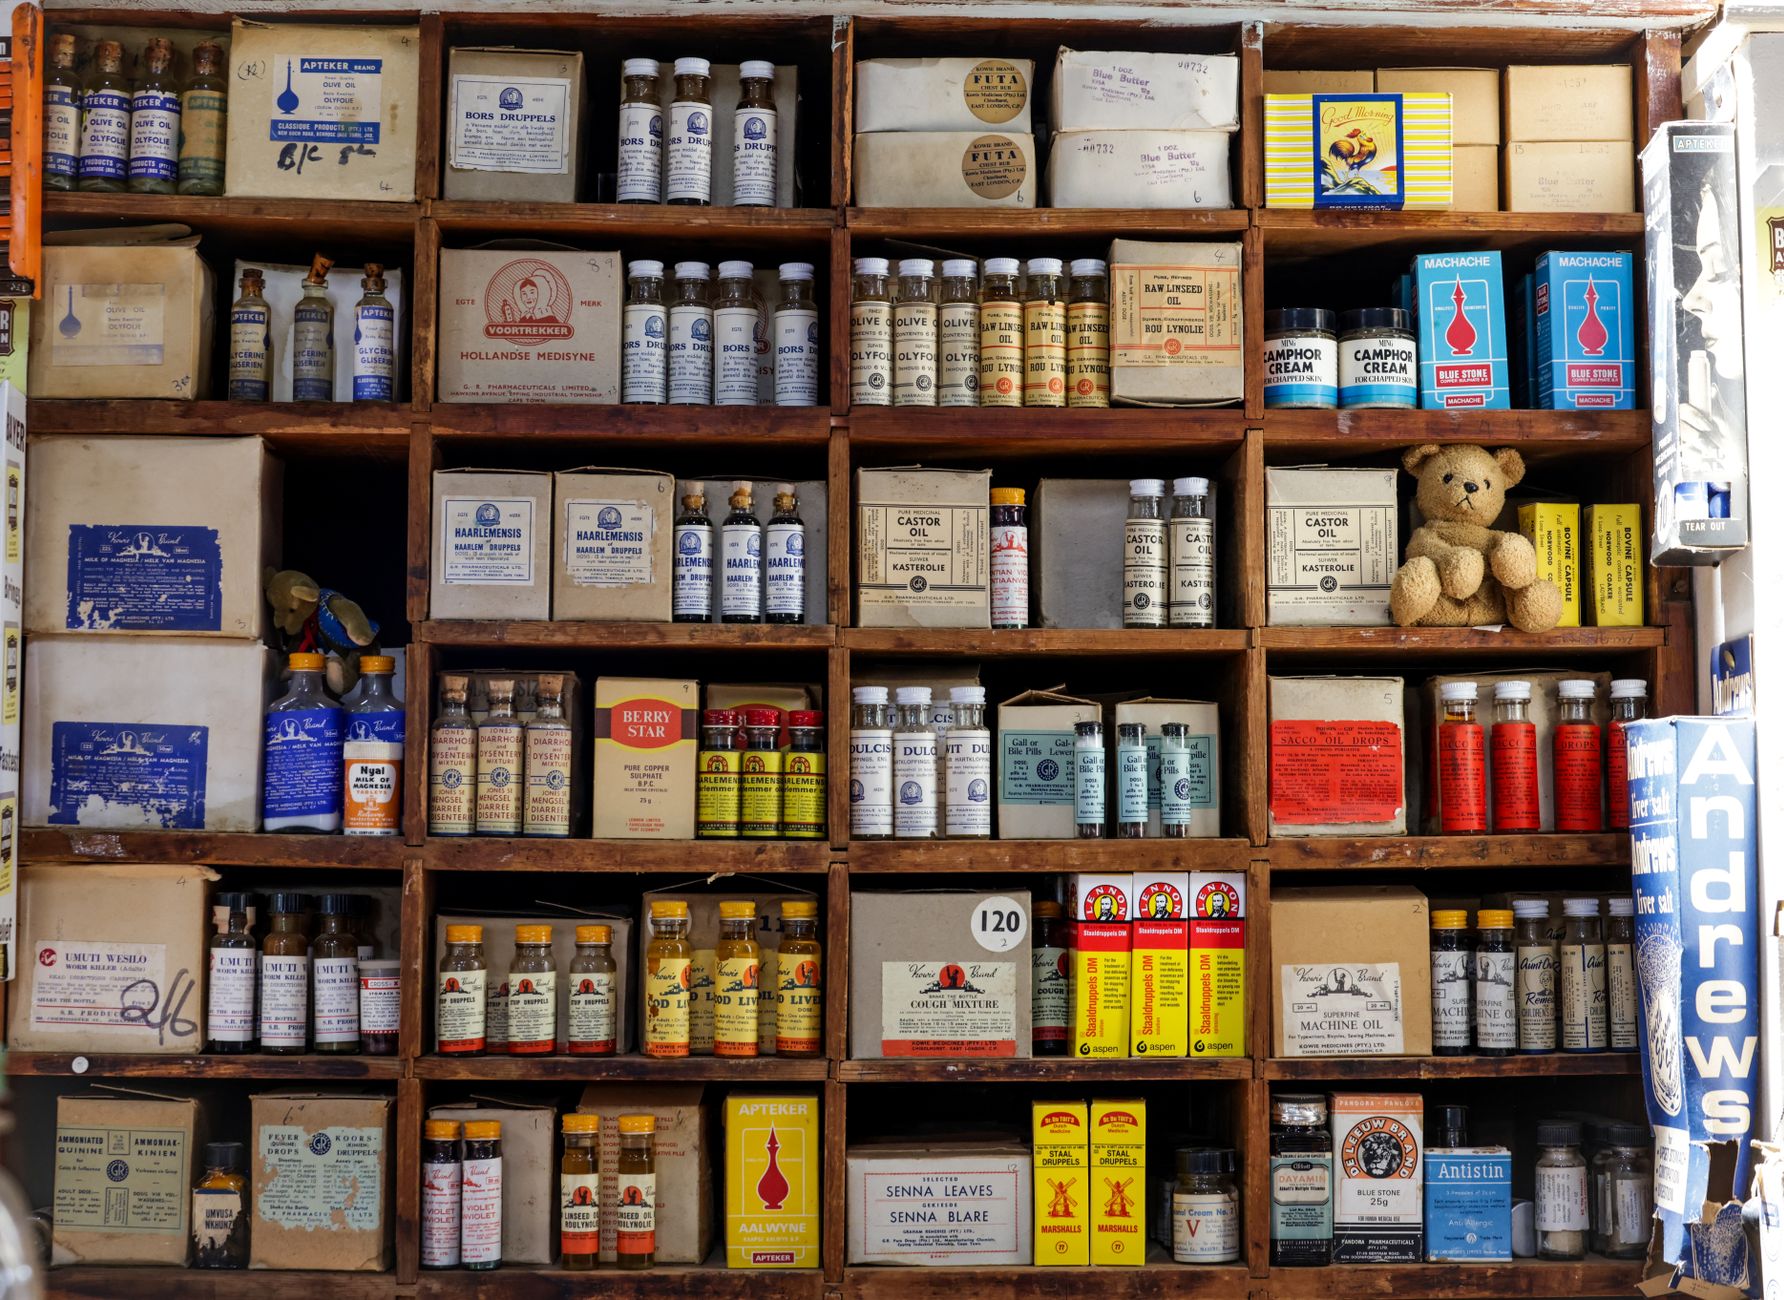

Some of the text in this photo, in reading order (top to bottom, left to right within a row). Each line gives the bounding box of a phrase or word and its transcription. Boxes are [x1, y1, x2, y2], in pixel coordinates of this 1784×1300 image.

[303, 61, 349, 71] APTEKER
[974, 74, 1018, 84] FUTA
[1093, 68, 1150, 86] Blue Butter
[466, 111, 555, 122] BORS DRUPPELS
[1321, 106, 1395, 127] Good Morning
[315, 123, 345, 131] PRODUCTS
[1424, 256, 1490, 269] MACHACHE
[1559, 257, 1623, 267] MACHACHE
[1144, 284, 1203, 294] RAW LINSEED
[1167, 296, 1182, 306] OIL
[488, 326, 569, 335] VOORTREKKER
[1145, 324, 1204, 334] ROU LYNOLIE
[1281, 339, 1296, 347] MING
[723, 344, 750, 353] BORS
[461, 352, 595, 362] HOLLANDSE MEDISYNE
[1265, 348, 1321, 361] CAMPHOR
[1354, 349, 1413, 362] CAMPHOR
[1269, 362, 1314, 373] CREAM
[1364, 362, 1407, 374] CREAM
[1439, 369, 1488, 379] BLUE STONE
[1571, 369, 1618, 378] BLUE STONE
[1275, 376, 1304, 384] CHAPPED
[898, 517, 941, 527] CASTOR
[1306, 518, 1348, 528] CASTOR
[1685, 522, 1726, 532] TEAR OUT
[455, 527, 521, 538] HAARLEMENSIS
[576, 530, 643, 542] HAARLEMENSIS
[909, 528, 928, 537] OIL
[1318, 529, 1336, 539] OIL
[454, 543, 521, 551] HAARLEM DRUPPELS
[892, 563, 945, 572] KASTEROLIE
[1302, 564, 1355, 573] KASTEROLIE
[1564, 560, 1572, 603] CAPSULE
[1384, 693, 1392, 704] 5
[623, 710, 672, 725] BERRY
[628, 725, 665, 737] STAR
[1012, 738, 1027, 747] Gall
[1281, 737, 1389, 746] SACCO OIL DROPS
[479, 751, 521, 759] DYSENTERY
[1024, 747, 1042, 755] Pills
[1627, 737, 1675, 780] Andrews
[360, 766, 385, 776] Nyal
[479, 793, 511, 803] MENGSEL
[1631, 786, 1670, 819] liver salt
[1631, 832, 1676, 875] Andrews
[1087, 886, 1127, 917] LENNON
[1141, 884, 1182, 914] LENNON
[1198, 882, 1239, 914] LENNON
[1636, 886, 1674, 914] liver salt
[980, 910, 1020, 932] 120
[1680, 723, 1757, 1136] Andrews
[65, 954, 147, 964] UMUTI WESILO
[1086, 958, 1099, 1038] Staaldruppels DM
[1142, 955, 1155, 1036] Staaldruppels DM
[1200, 954, 1213, 1034] Staaldruppels DM
[911, 1000, 999, 1009] COUGH MIXTURE
[1300, 1019, 1383, 1030] MACHINE OIL
[1092, 1044, 1119, 1055] aspen
[739, 1103, 808, 1115] APTEKER
[58, 1136, 104, 1145] AMMONIATED
[134, 1138, 180, 1146] AMMONIAK-
[268, 1133, 299, 1141] FEVER
[58, 1146, 103, 1156] QUININE
[267, 1147, 300, 1156] DROPS
[1346, 1118, 1416, 1178] DE LEEUW BRAND
[138, 1149, 176, 1158] KINIEN
[1049, 1150, 1073, 1158] STAAL
[1042, 1157, 1080, 1166] DRUPPELS
[1099, 1157, 1137, 1165] DRUPPELS
[1438, 1162, 1504, 1179] Antistin
[1279, 1175, 1326, 1184] DAYAMIN
[886, 1185, 993, 1197] SENNA LEAVES
[1370, 1197, 1388, 1207] 25g
[205, 1209, 233, 1218] UMVUSA
[890, 1210, 989, 1223] SENNA BLARE
[739, 1223, 807, 1234] AALWYNE
[1041, 1225, 1082, 1234] MARSHALLS
[1186, 1220, 1200, 1238] V
[755, 1253, 791, 1262] APTEKER
